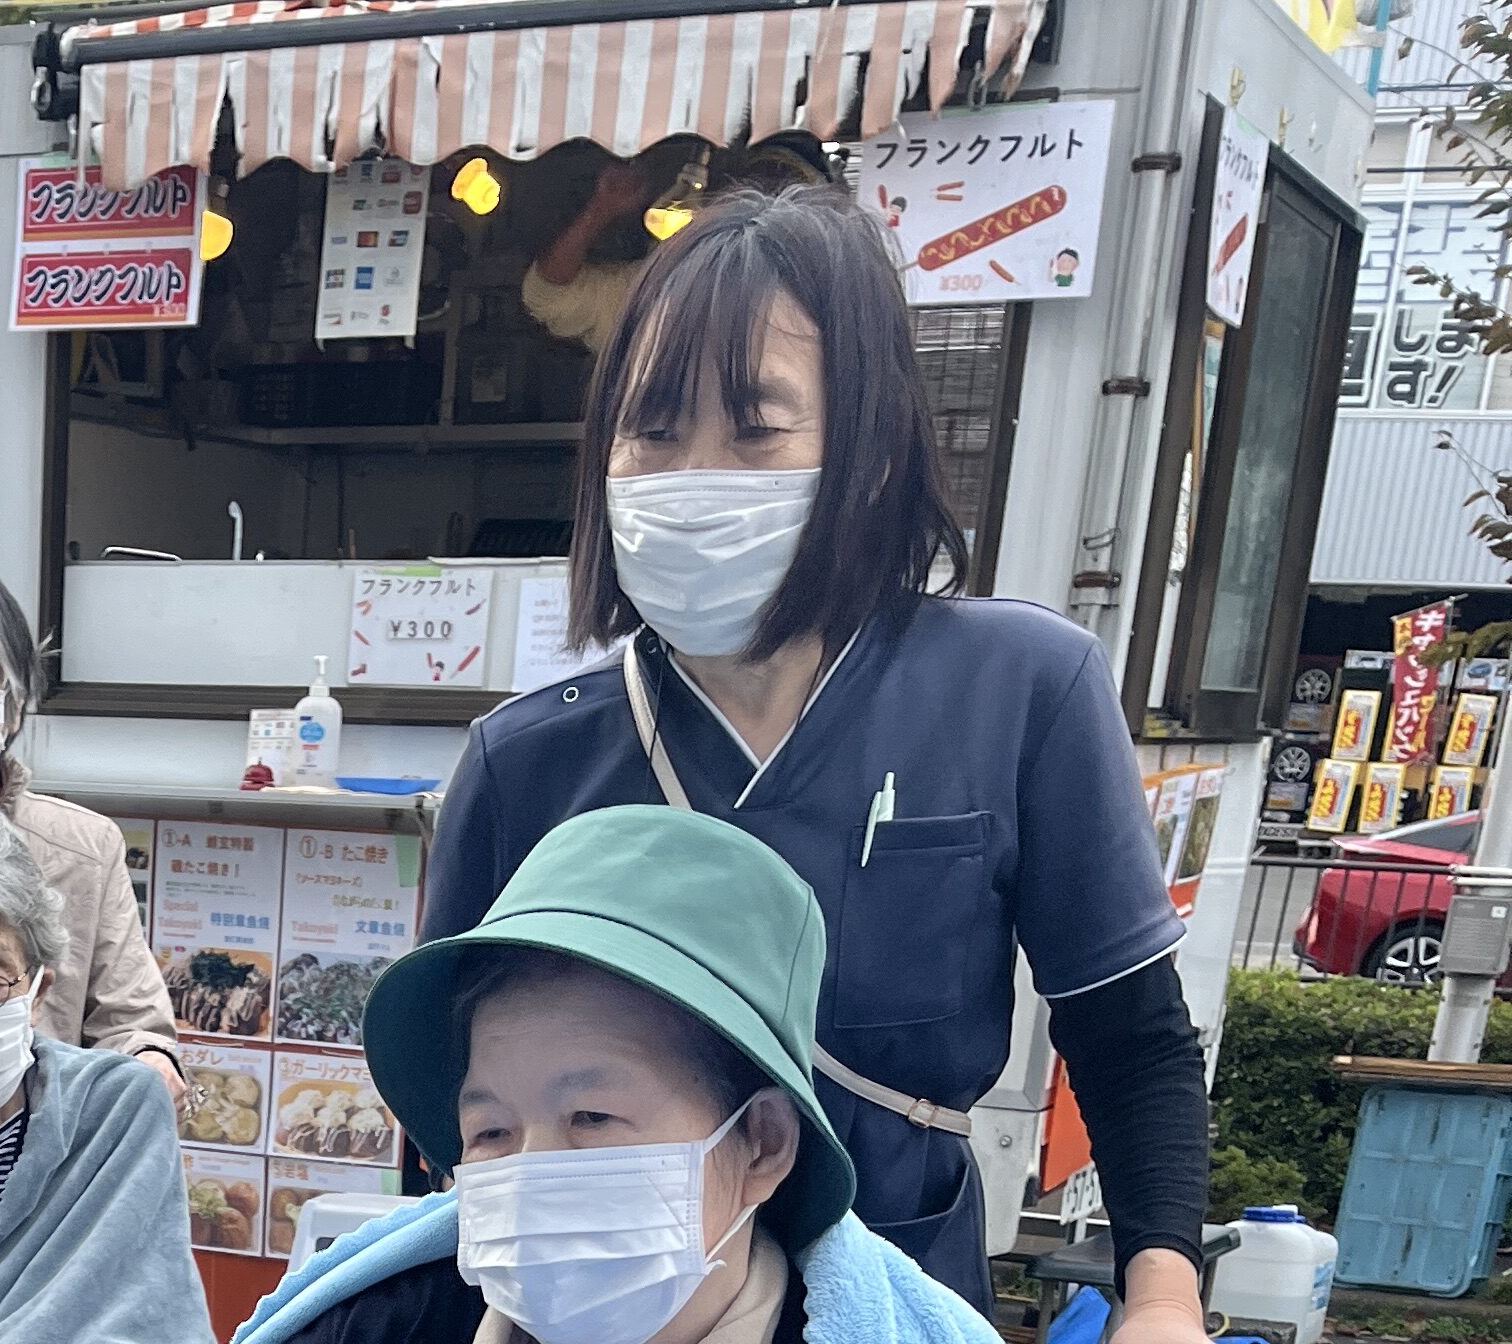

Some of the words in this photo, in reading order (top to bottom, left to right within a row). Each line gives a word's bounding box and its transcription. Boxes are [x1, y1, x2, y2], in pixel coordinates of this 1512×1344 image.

[876, 128, 1084, 169] フランクフルト
[27, 262, 183, 304] フランクフルト
[361, 578, 477, 596] フランクフルト
[390, 620, 452, 638] ¥300
